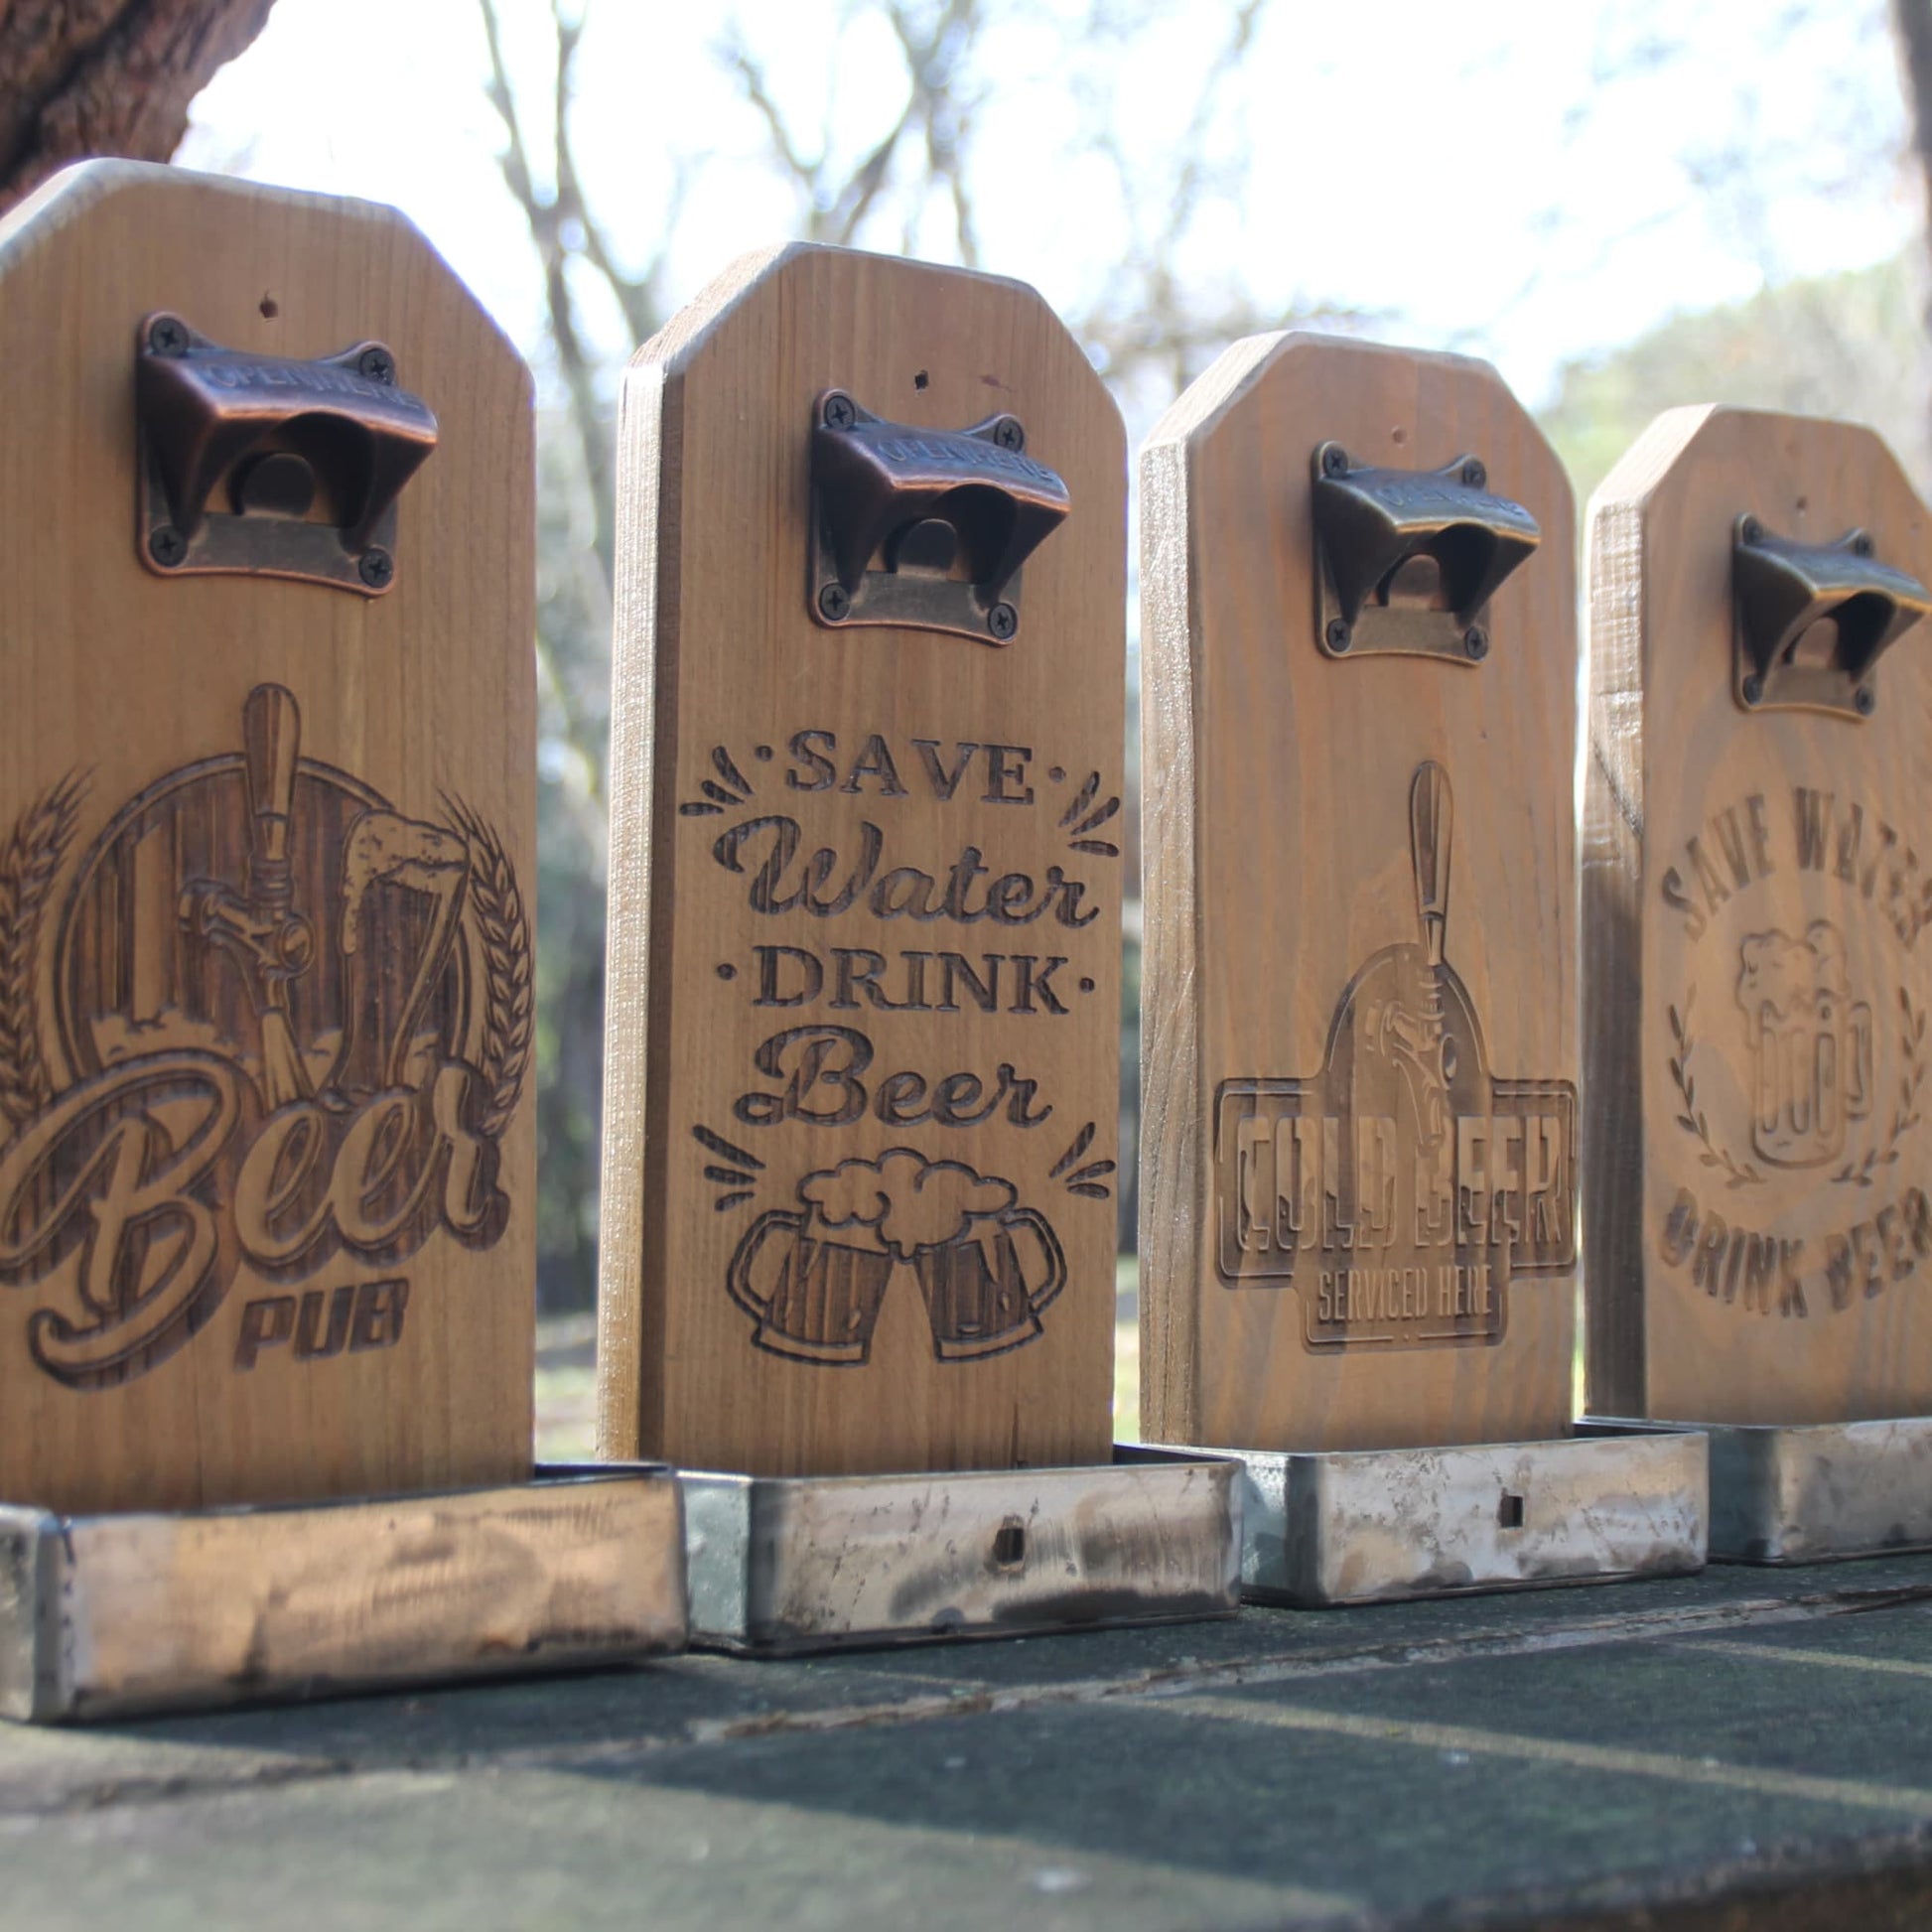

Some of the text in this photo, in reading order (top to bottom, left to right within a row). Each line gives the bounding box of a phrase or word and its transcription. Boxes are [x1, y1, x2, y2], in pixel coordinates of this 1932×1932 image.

[784, 730, 1035, 805] SAVE
[712, 814, 1100, 928] Water
[1662, 793, 1775, 943] SAVE
[752, 945, 1069, 1014] DRINK
[733, 1024, 1052, 1128] Beer
[0, 1046, 511, 1393] Beer
[1236, 1115, 1563, 1251] COLD BEER
[1317, 1265, 1492, 1320] SERVICED HERE
[1660, 1187, 1807, 1318] DRINK
[233, 1278, 410, 1372] PUB
